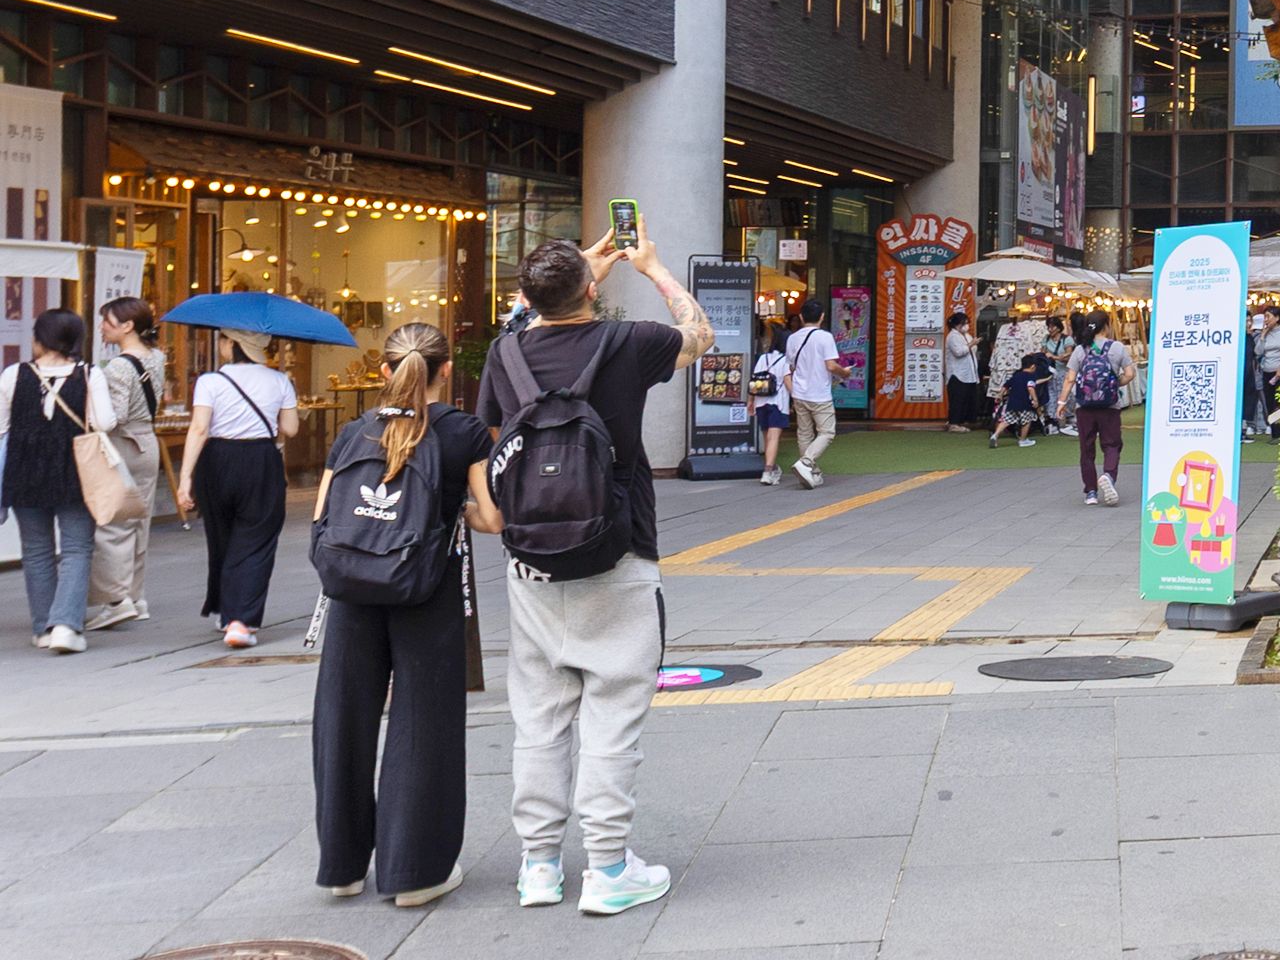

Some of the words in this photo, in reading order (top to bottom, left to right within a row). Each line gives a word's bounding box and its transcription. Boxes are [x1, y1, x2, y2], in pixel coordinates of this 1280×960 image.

[880, 218, 968, 250] 인싸골
[900, 246, 949, 258] INSSAGOL
[920, 255, 932, 263] 4F
[1184, 313, 1210, 327] 방문객
[1161, 329, 1233, 349] 설문조사QR
[353, 506, 398, 521] adidas
